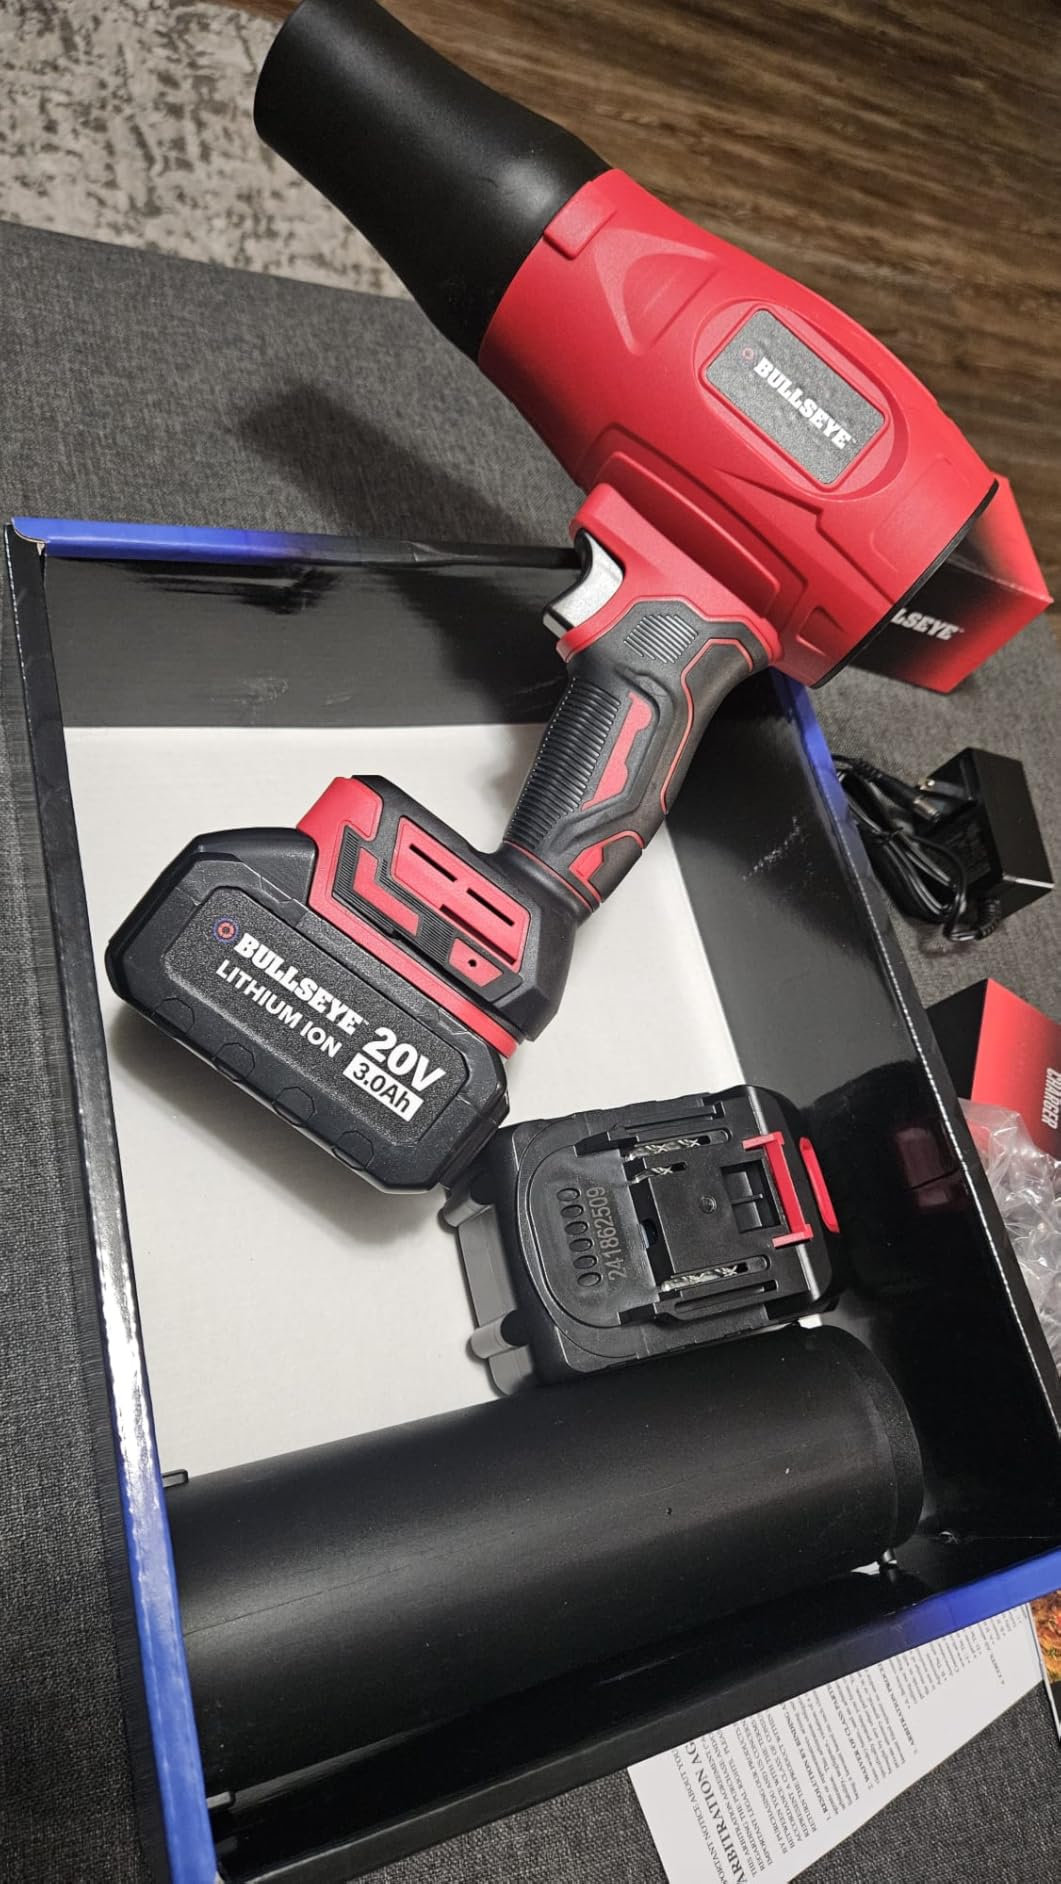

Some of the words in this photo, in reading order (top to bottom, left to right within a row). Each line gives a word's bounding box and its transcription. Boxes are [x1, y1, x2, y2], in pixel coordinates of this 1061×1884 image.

[754, 357, 853, 449] BULLSEYE
[889, 608, 959, 640] LSEYE
[234, 932, 364, 1035] BULLSEYE
[216, 959, 303, 1029] LITHIUM
[300, 1021, 343, 1058] ION
[362, 1027, 446, 1092] 20V
[353, 1062, 411, 1113] 3.0Ah
[1041, 1067, 1061, 1129] CHARGER
[586, 1186, 627, 1281] 241862509
[785, 1712, 801, 1747] BINDING
[761, 1746, 771, 1765] THE
[768, 1764, 779, 1787] WITH
[778, 1744, 797, 1782] PRODUCT
[799, 1748, 806, 1760] BY
[680, 1771, 697, 1803] ABOUT
[719, 1759, 739, 1803] PURCHASE
[762, 1771, 772, 1789] AND
[769, 1790, 779, 1809] YOU
[794, 1781, 803, 1799] THE
[804, 1759, 828, 1814] RESOLUTION
[693, 1804, 711, 1841] NOTICE
[696, 1768, 747, 1884] ARBITRATION
[726, 1801, 750, 1856] ARBITRATION
[737, 1805, 746, 1821] THE
[707, 1842, 728, 1884] PORTANT
[743, 1821, 766, 1871] REGARDING
[751, 1818, 773, 1866] IMPORTANT
